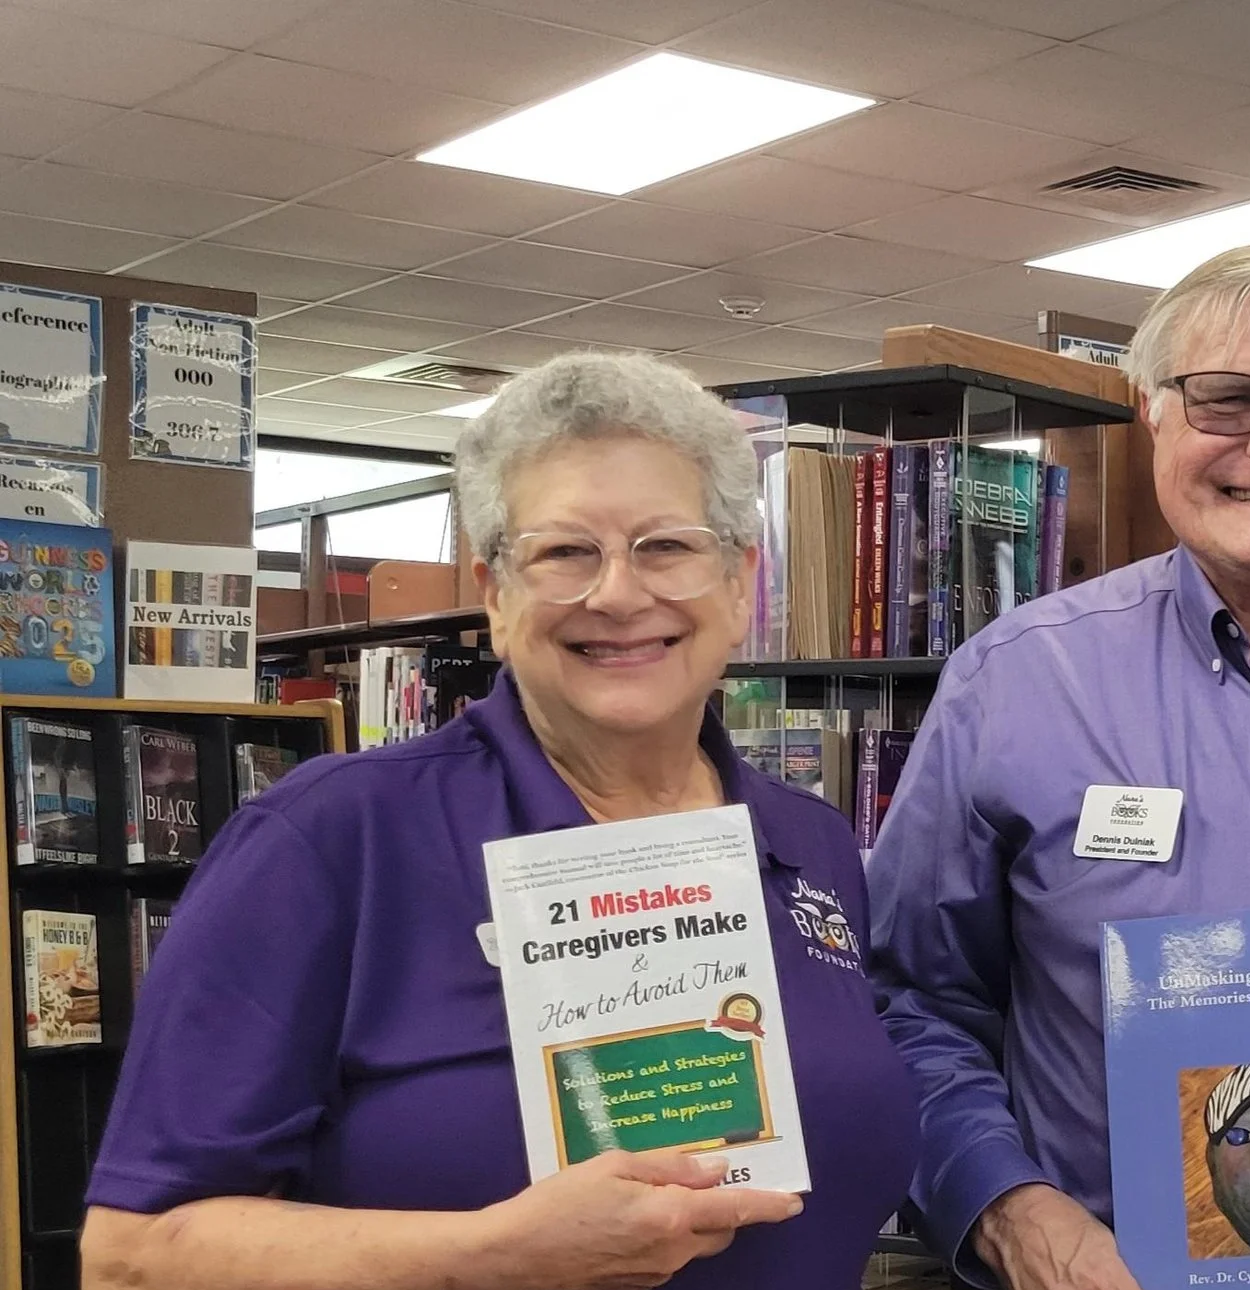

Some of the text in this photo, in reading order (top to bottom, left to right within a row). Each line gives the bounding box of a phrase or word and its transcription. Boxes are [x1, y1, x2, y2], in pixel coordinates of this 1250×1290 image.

[0, 308, 89, 334] eference
[1087, 349, 1120, 367] Adult
[174, 367, 214, 388] 000
[953, 477, 1034, 508] DEBRA
[24, 505, 45, 517] en
[954, 498, 1030, 527] WEBB
[0, 538, 107, 572] GUINNESS
[0, 569, 101, 597] WORLD
[132, 605, 252, 628] New Arrivals
[0, 614, 106, 664] 2025
[140, 733, 165, 747] CARL
[145, 795, 200, 828] BLACK
[167, 829, 181, 855] 2
[1084, 845, 1159, 857] President and Founder
[1092, 834, 1156, 848] Dennis Dulniak
[548, 883, 713, 926] 21 Mistakes
[42, 929, 69, 945] HONEY
[522, 910, 749, 965] Caregivers Make
[631, 952, 650, 973] &
[537, 960, 750, 1033] How to Avoid Them
[1146, 997, 1177, 1012] The
[562, 1050, 747, 1091] Solutions and Strategies
[578, 1072, 739, 1112] to Reduce Stress and
[590, 1099, 734, 1132] Increase Happiness
[1188, 1273, 1214, 1286] Rev.
[1216, 1271, 1236, 1284] Dr.
